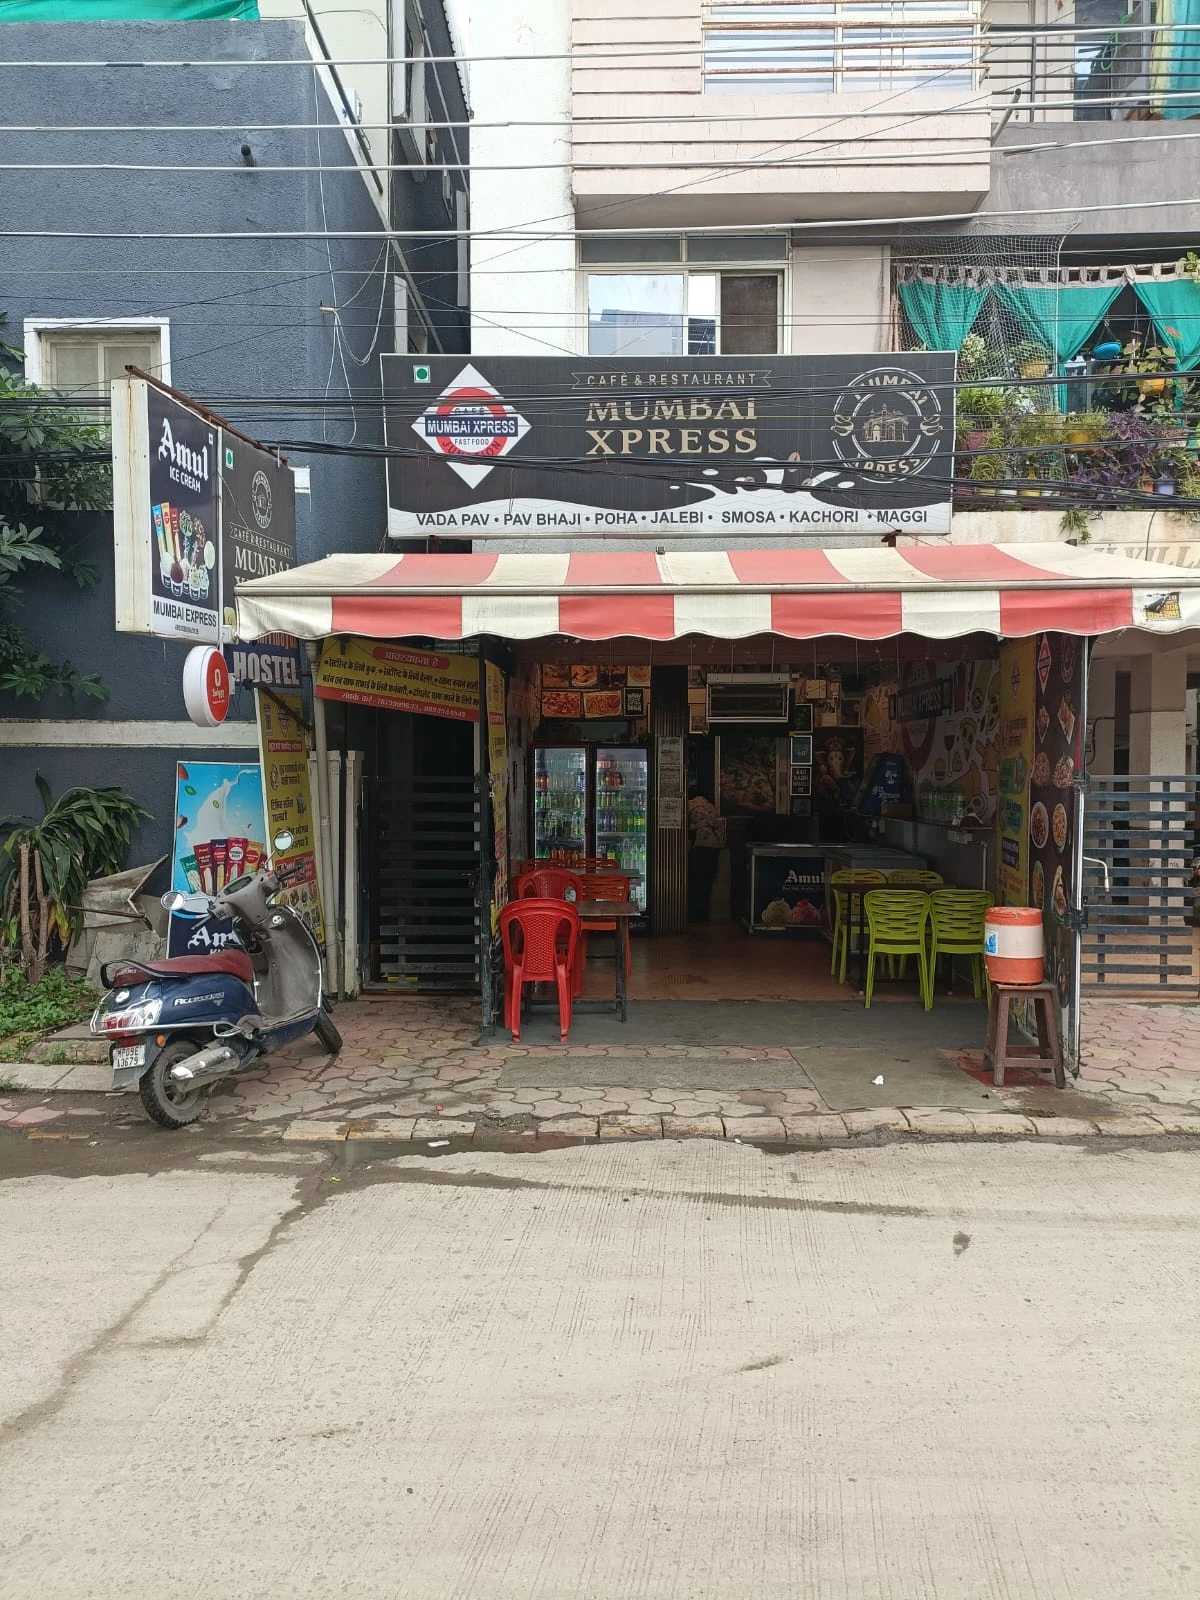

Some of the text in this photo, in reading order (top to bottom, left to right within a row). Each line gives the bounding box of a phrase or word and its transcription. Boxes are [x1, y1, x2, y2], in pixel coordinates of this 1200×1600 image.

[634, 374, 642, 387] &
[648, 372, 756, 386] RESTAURANT
[585, 397, 758, 422] MUMBAI
[473, 420, 516, 434] XPRESS
[158, 417, 209, 482] Amul
[454, 438, 490, 446] FAST FOOD
[585, 427, 758, 455] XPRESS
[169, 465, 201, 493] ICE CREAM
[416, 510, 927, 526] VADA PAV PAV BHAJI POHA JALEBI SMOSA KACHORI MAGGI
[153, 600, 217, 628] MUMBAI EXPRESS
[233, 651, 300, 685] HOSTEL
[785, 869, 825, 885] Amul
